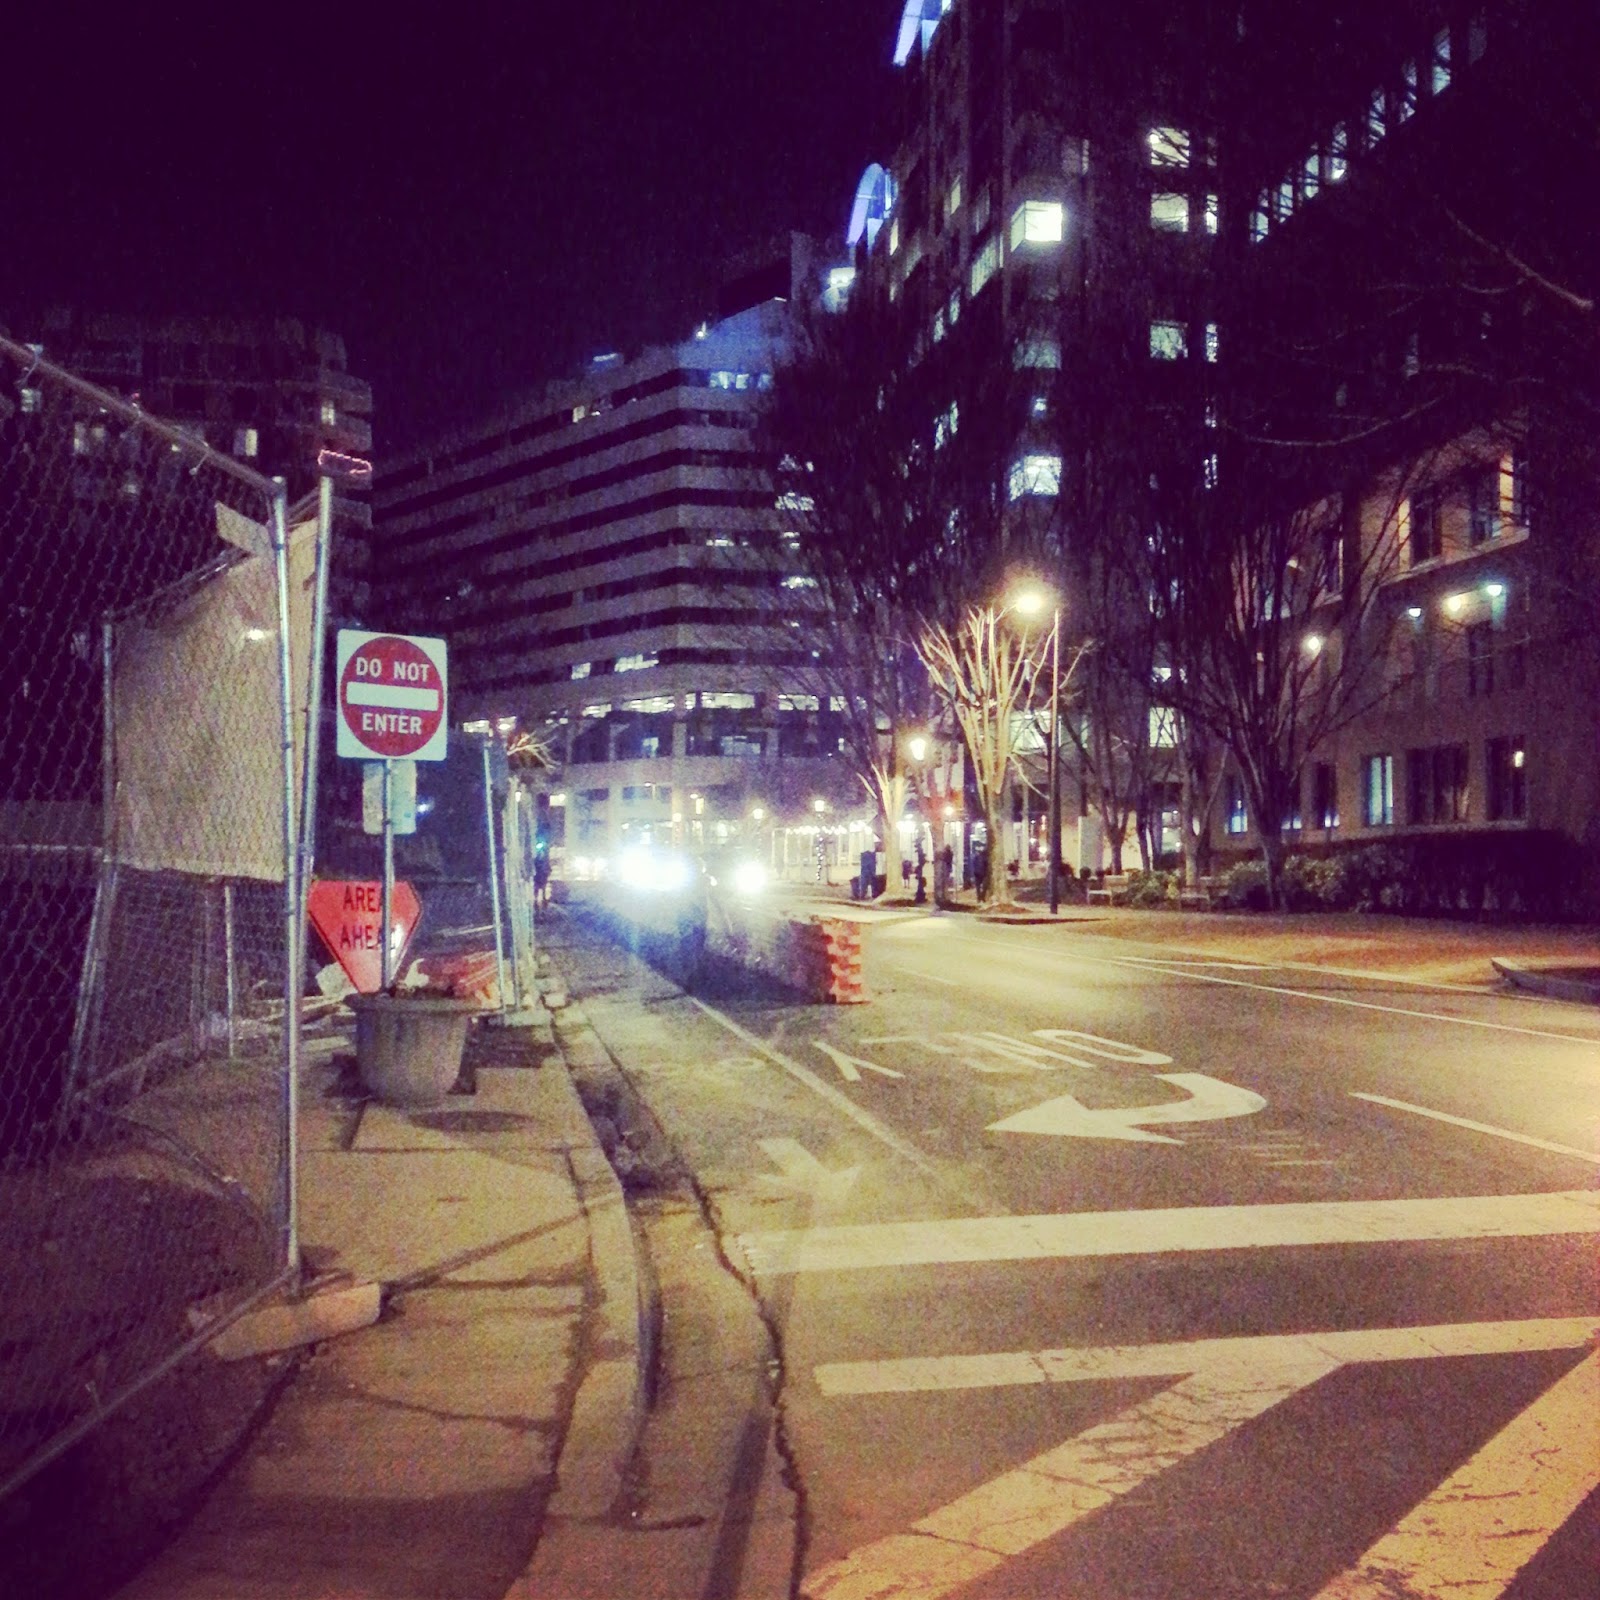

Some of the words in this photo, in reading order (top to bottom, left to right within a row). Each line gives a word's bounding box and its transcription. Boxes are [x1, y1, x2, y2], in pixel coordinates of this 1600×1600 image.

[356, 656, 382, 678] DO
[393, 660, 429, 682] NOT
[362, 712, 422, 735] ENTER
[340, 924, 396, 950] AHE
